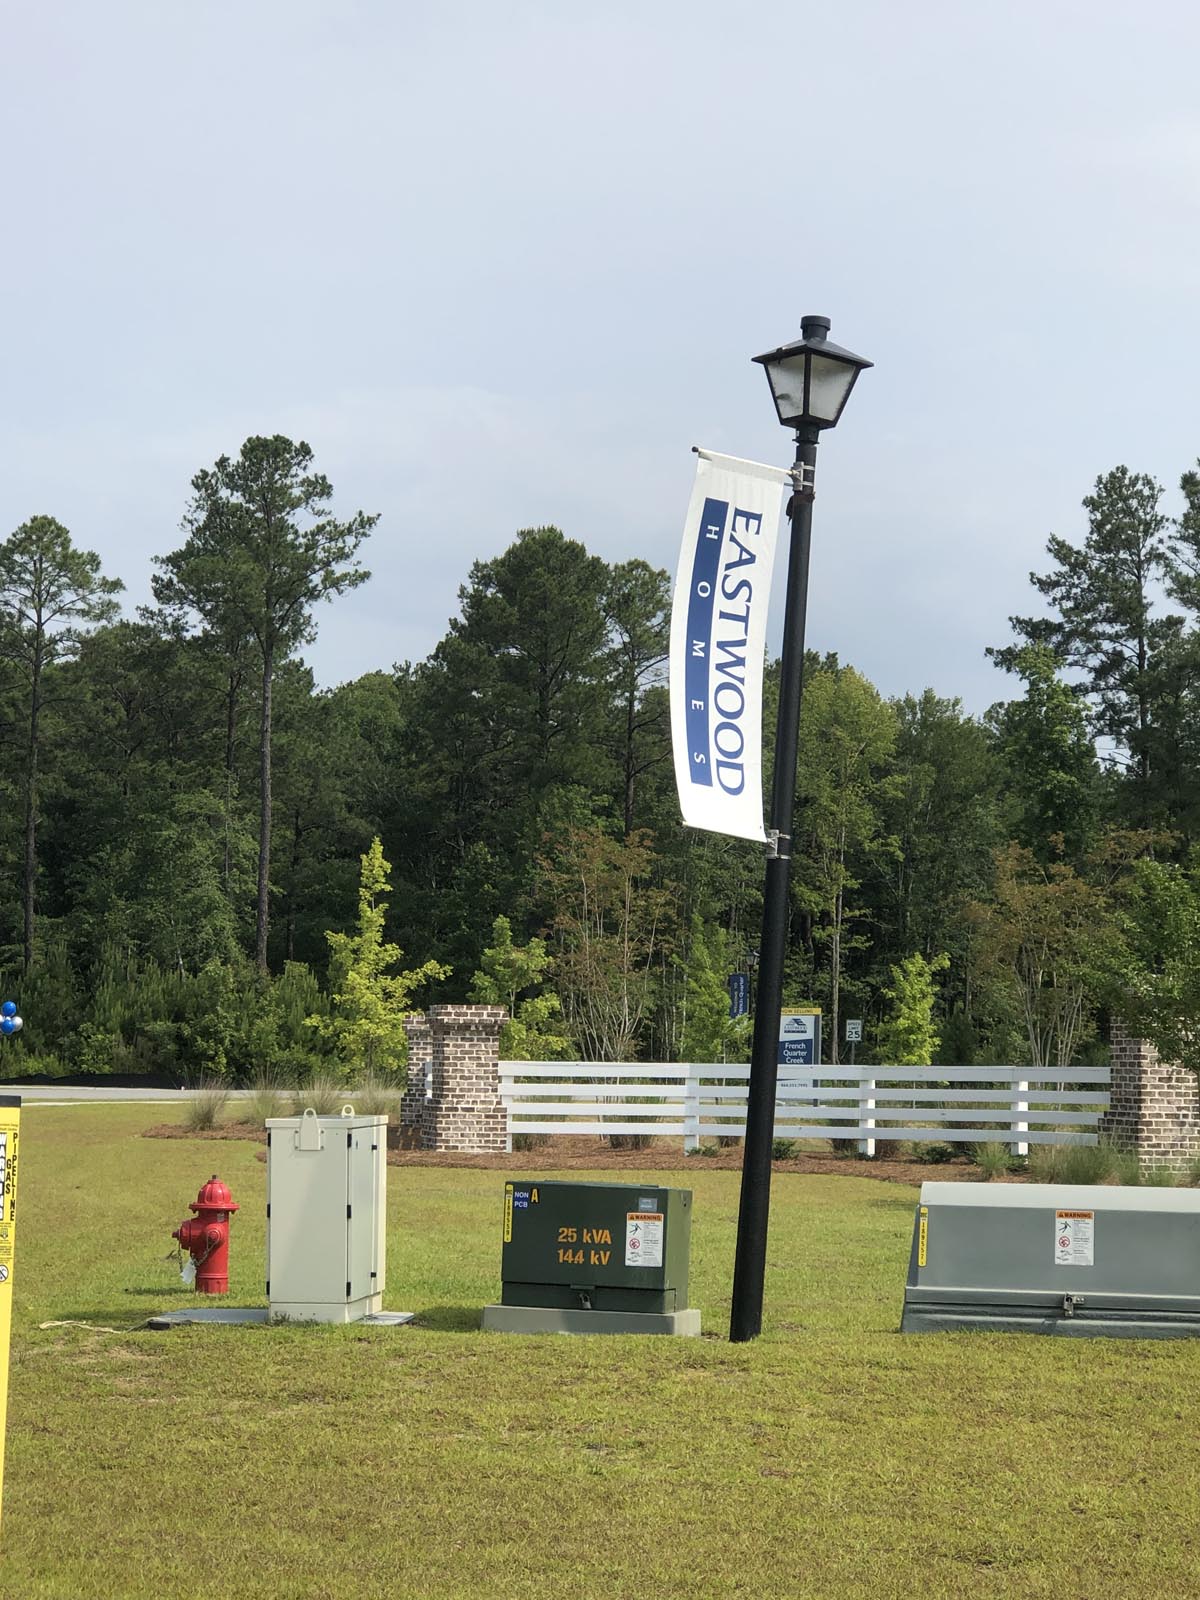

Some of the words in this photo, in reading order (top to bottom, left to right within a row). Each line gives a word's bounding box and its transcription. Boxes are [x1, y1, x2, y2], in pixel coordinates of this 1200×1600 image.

[691, 525, 720, 764] HOMES
[714, 507, 763, 796] EASTWOOD
[847, 1030, 861, 1039] 25
[783, 1049, 808, 1057] Quarter
[785, 1056, 804, 1064] Creek
[10, 1132, 18, 1221] PIPELINE
[530, 1188, 539, 1203] A
[1064, 1211, 1092, 1219] WARNING
[558, 1227, 577, 1243] 25
[582, 1228, 612, 1245] kVA
[590, 1250, 611, 1265] kV
